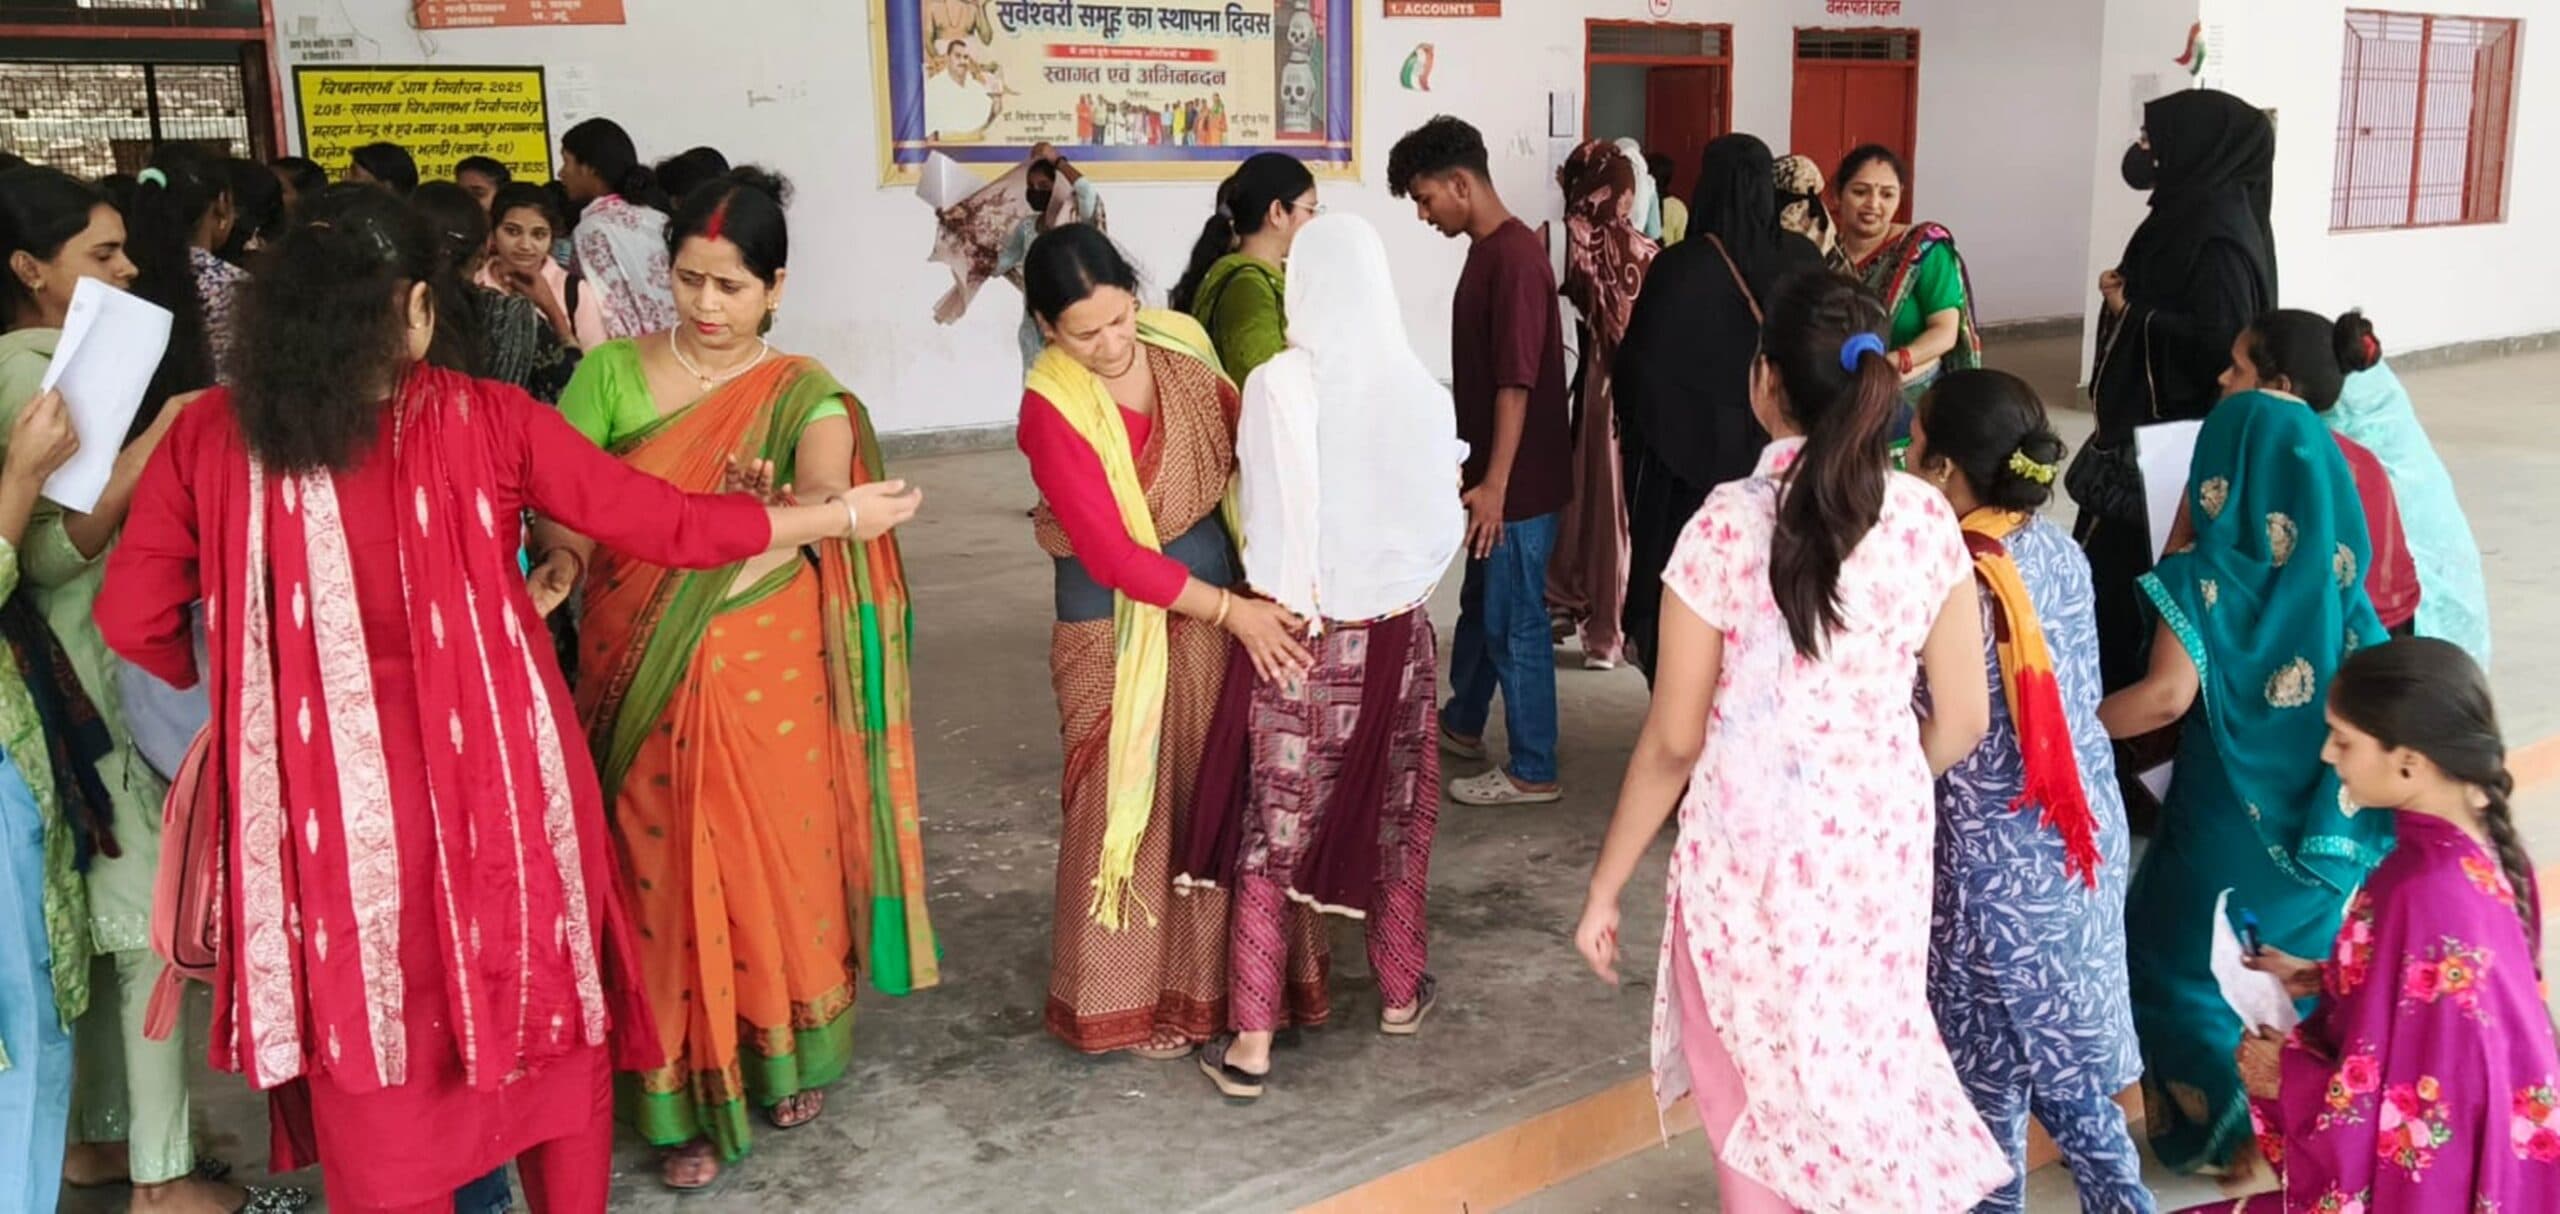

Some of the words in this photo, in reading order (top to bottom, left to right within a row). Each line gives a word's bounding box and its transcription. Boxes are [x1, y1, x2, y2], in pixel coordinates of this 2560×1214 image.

[1404, 3, 1476, 15] ACCOUNTS
[1077, 4, 1123, 38] समूह
[1126, 7, 1153, 30] का
[1157, 8, 1221, 33] स्थापना
[1225, 3, 1271, 36] दिवस
[1043, 66, 1101, 84] स्वागत
[1107, 62, 1131, 84] एवं
[1136, 64, 1227, 86] अभिनन्दन
[318, 77, 392, 96] विधानसभा
[398, 81, 428, 95] आम
[405, 98, 469, 115] विधानसभा
